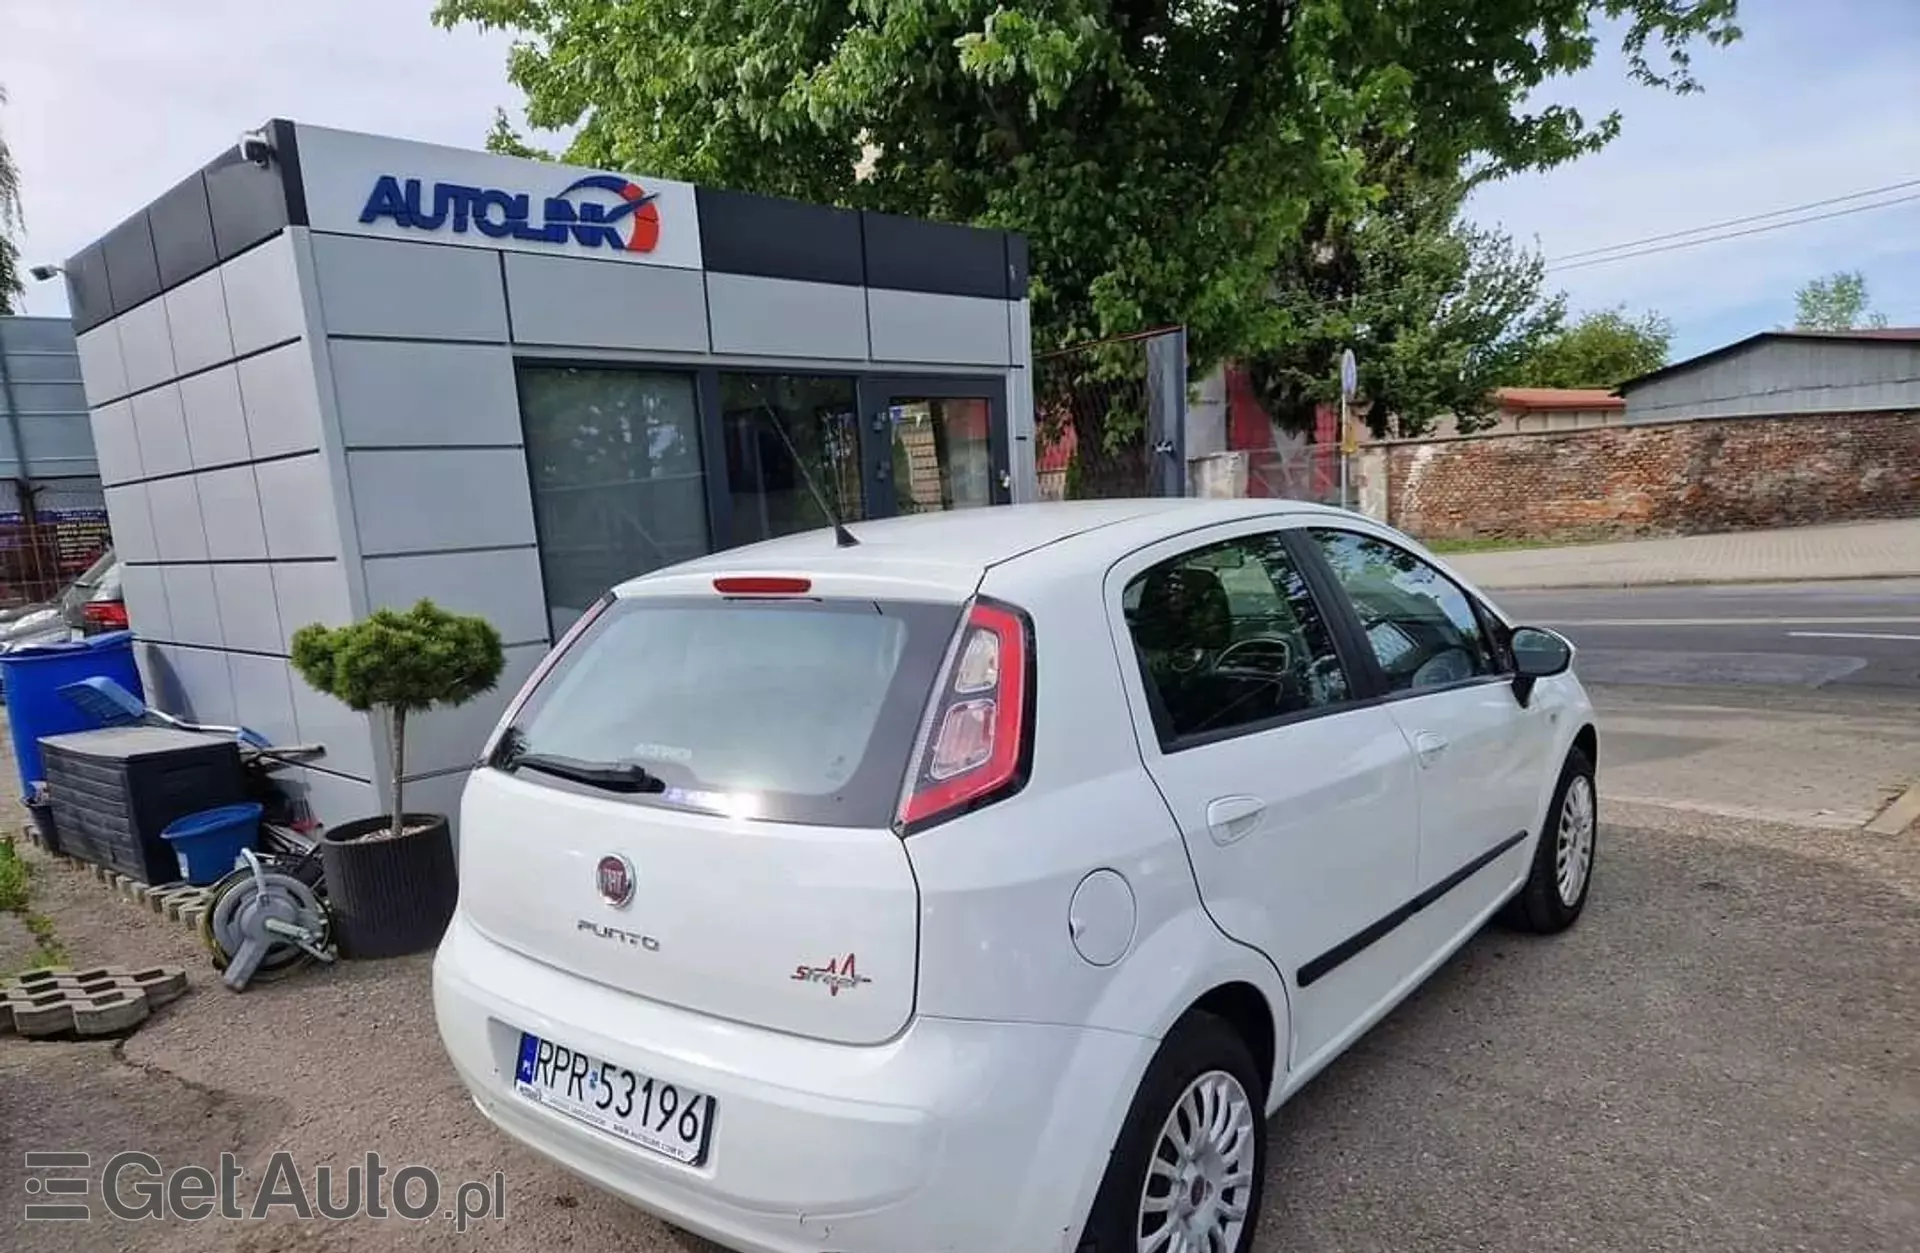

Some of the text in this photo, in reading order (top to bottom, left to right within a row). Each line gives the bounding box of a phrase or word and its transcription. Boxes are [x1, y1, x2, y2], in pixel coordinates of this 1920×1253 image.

[358, 175, 660, 253] AUTOLINK
[577, 919, 660, 952] PUNTO
[534, 1038, 701, 1143] RPR 53196
